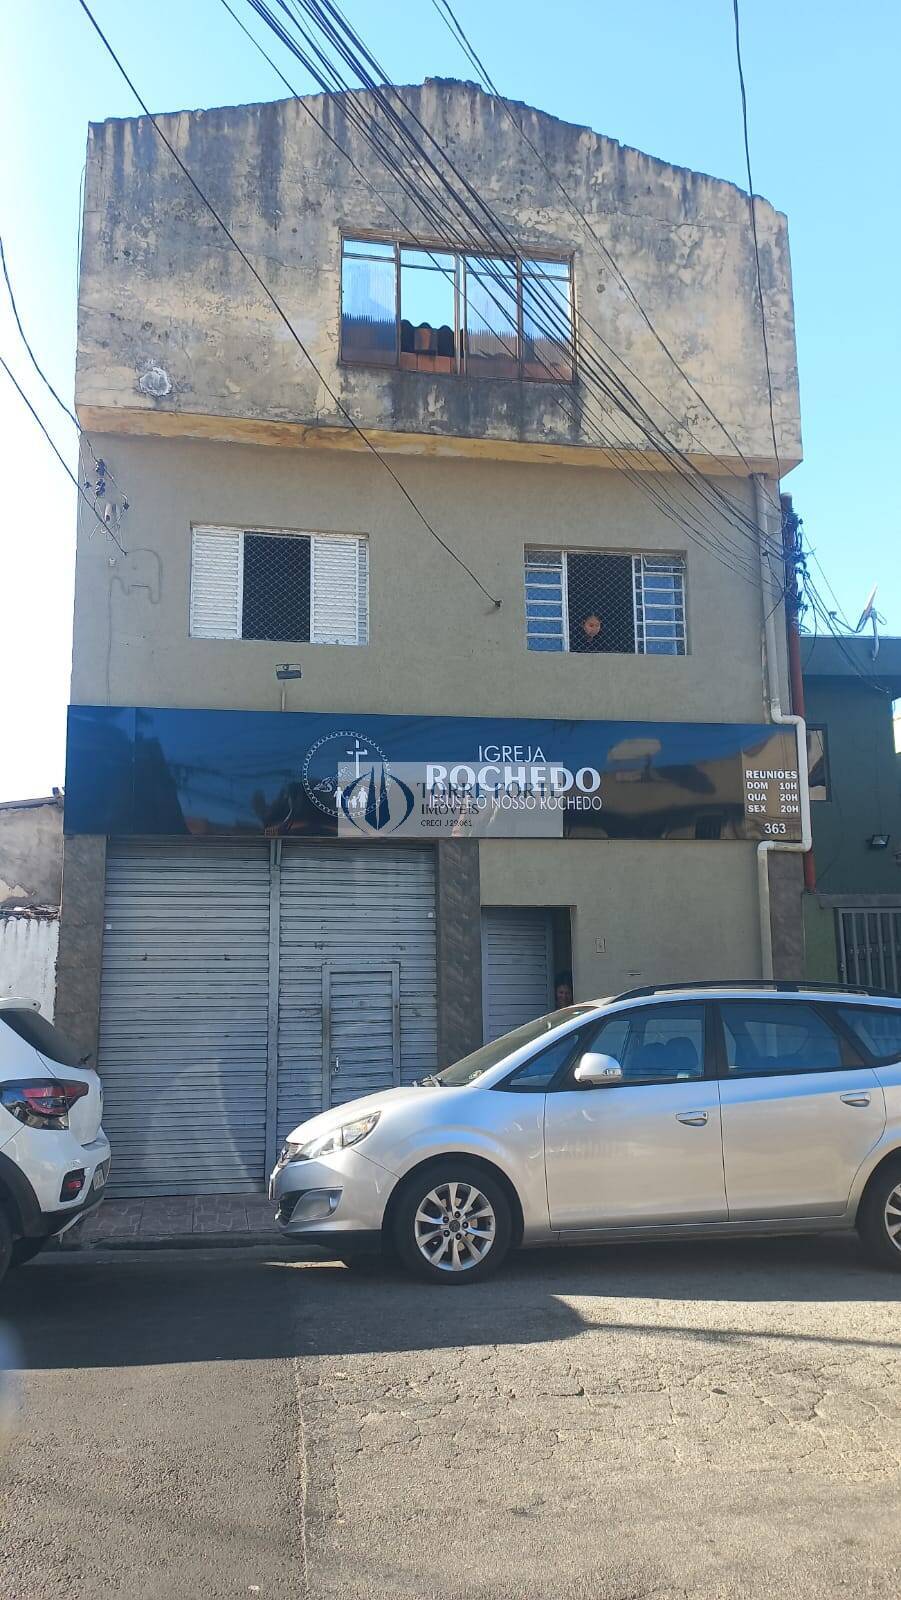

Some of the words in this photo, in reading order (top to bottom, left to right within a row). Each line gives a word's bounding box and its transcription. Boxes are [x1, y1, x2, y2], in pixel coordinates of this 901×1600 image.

[479, 745, 546, 763] IGREJA
[426, 764, 601, 793] ROCHEDO
[746, 768, 797, 779] REUNIÕES
[747, 781, 768, 789] DOM
[779, 782, 797, 790] 10H
[428, 794, 462, 809] JESUS
[476, 795, 487, 809] O
[491, 795, 536, 810] NOSSO
[540, 796, 603, 811] ROCHEDO
[748, 793, 767, 801] QUA
[780, 793, 798, 801] 20H
[764, 823, 785, 833] 363
